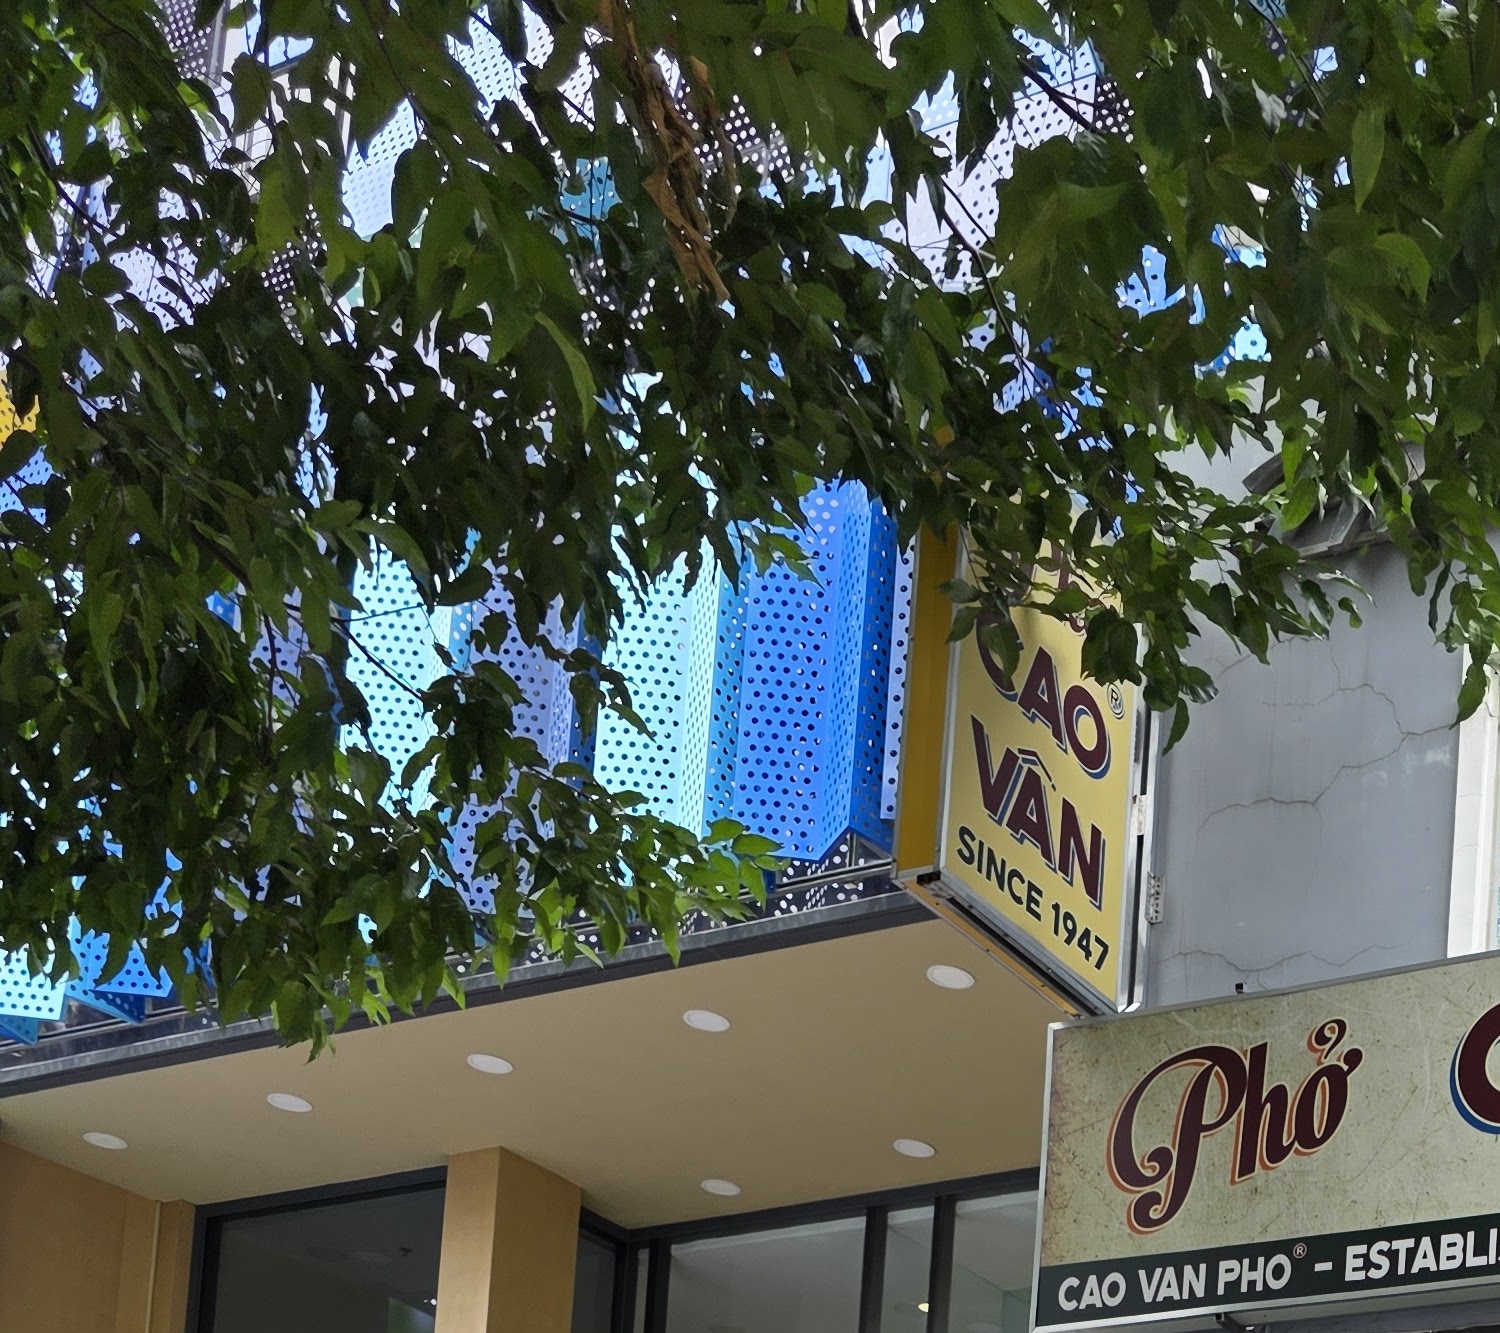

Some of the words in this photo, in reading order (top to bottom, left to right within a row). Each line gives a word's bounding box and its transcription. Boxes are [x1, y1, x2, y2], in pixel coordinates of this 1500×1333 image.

[970, 714, 1107, 911] VÂN
[956, 826, 1042, 922] SINCE
[1052, 903, 1110, 972] 1947
[1107, 1018, 1363, 1236] Phở
[1058, 1272, 1127, 1312] CAO
[1138, 1263, 1207, 1303] VAN
